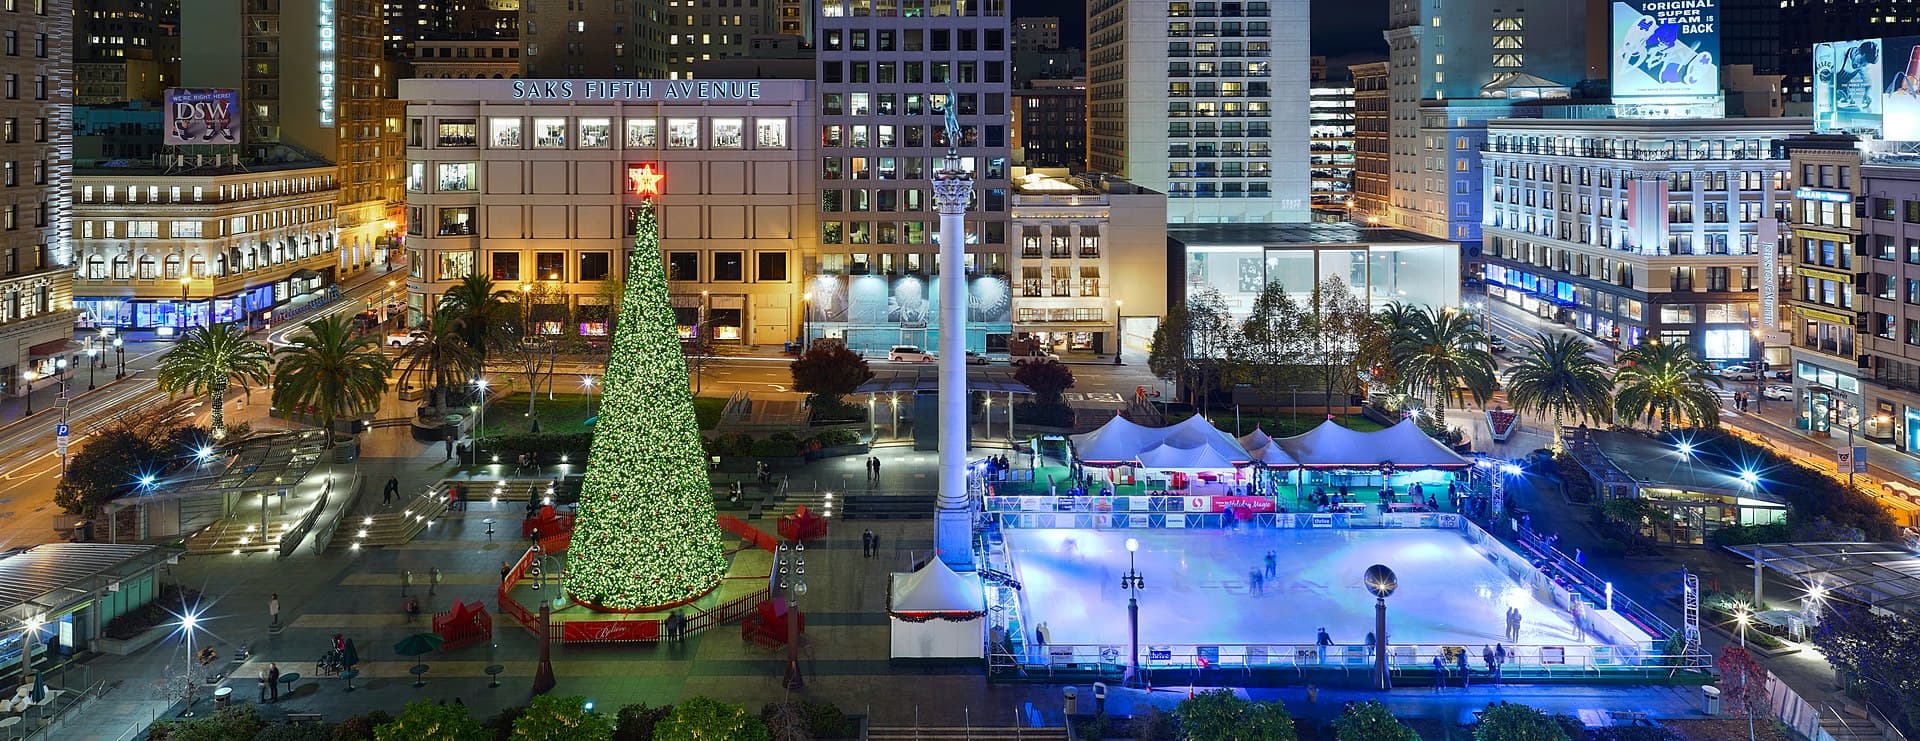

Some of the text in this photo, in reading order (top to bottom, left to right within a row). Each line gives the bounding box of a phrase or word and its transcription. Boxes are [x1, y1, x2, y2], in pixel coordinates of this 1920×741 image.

[1647, 0, 1714, 11] ORIGINAL
[1657, 9, 1700, 17] SUPER
[1658, 16, 1700, 25] TEAM
[1682, 23, 1714, 34] BACK
[321, 60, 333, 123] HOTEL
[513, 80, 761, 99] SAKS FIFTH AVENUE
[176, 102, 231, 120] DSW
